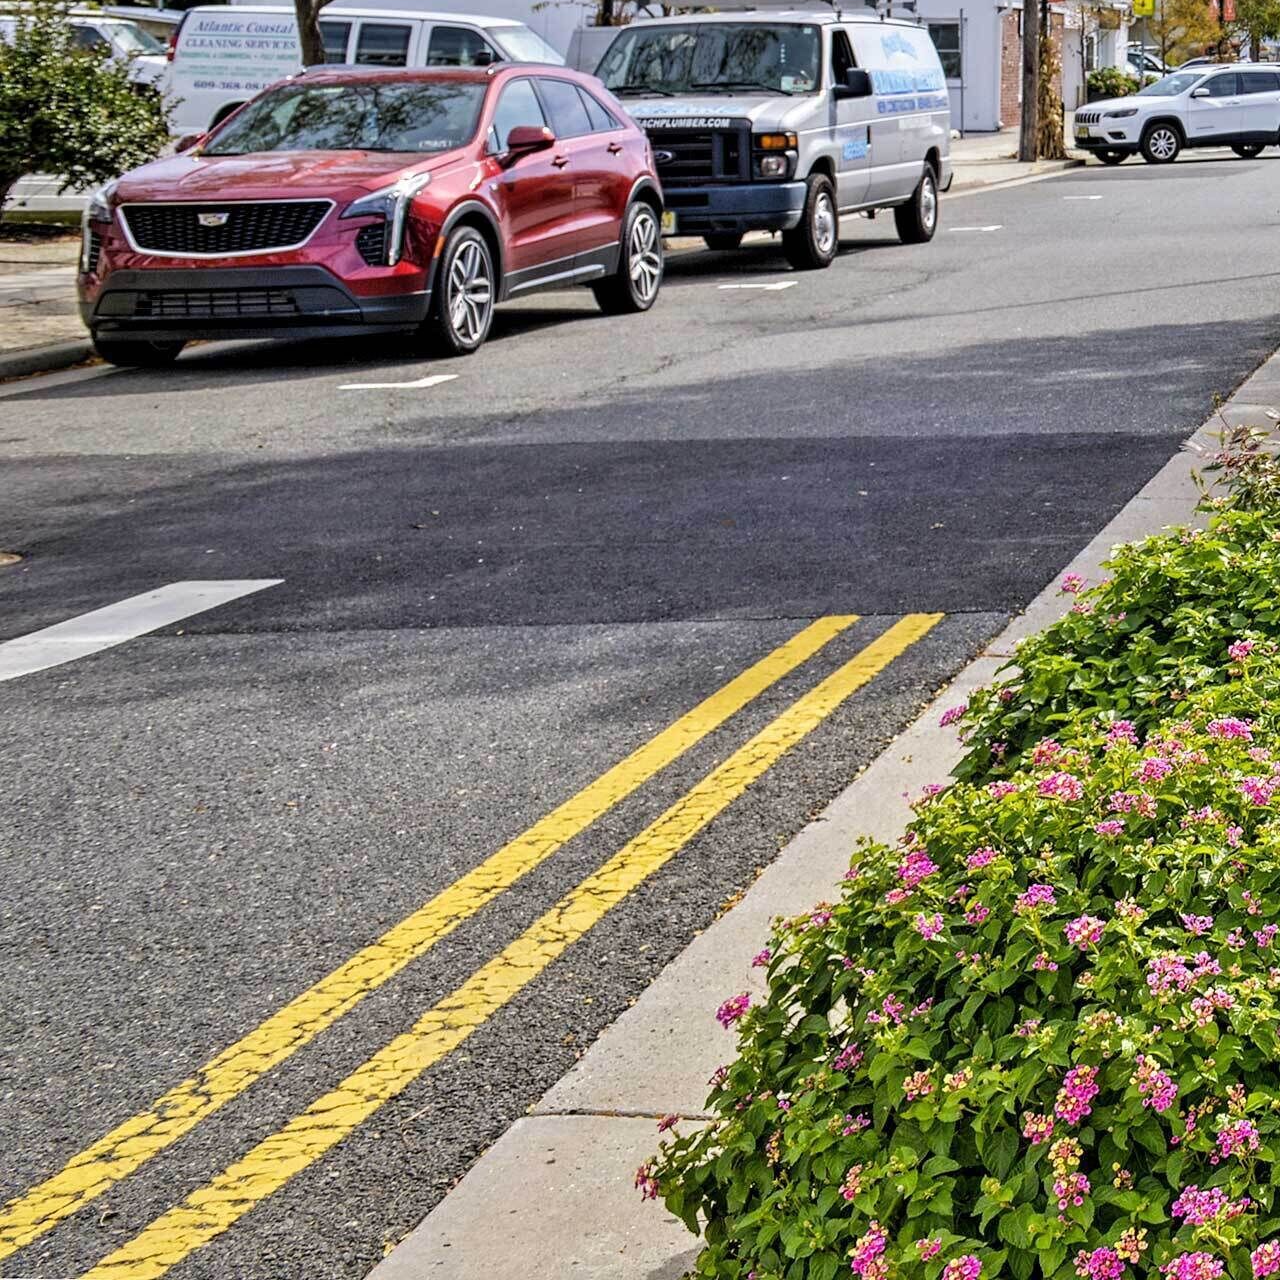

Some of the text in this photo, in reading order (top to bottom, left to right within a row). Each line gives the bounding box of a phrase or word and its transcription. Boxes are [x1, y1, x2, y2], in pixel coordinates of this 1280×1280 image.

[194, 22, 294, 33] Atlantic Coastal
[185, 38, 297, 49] CLEANING SERVICES
